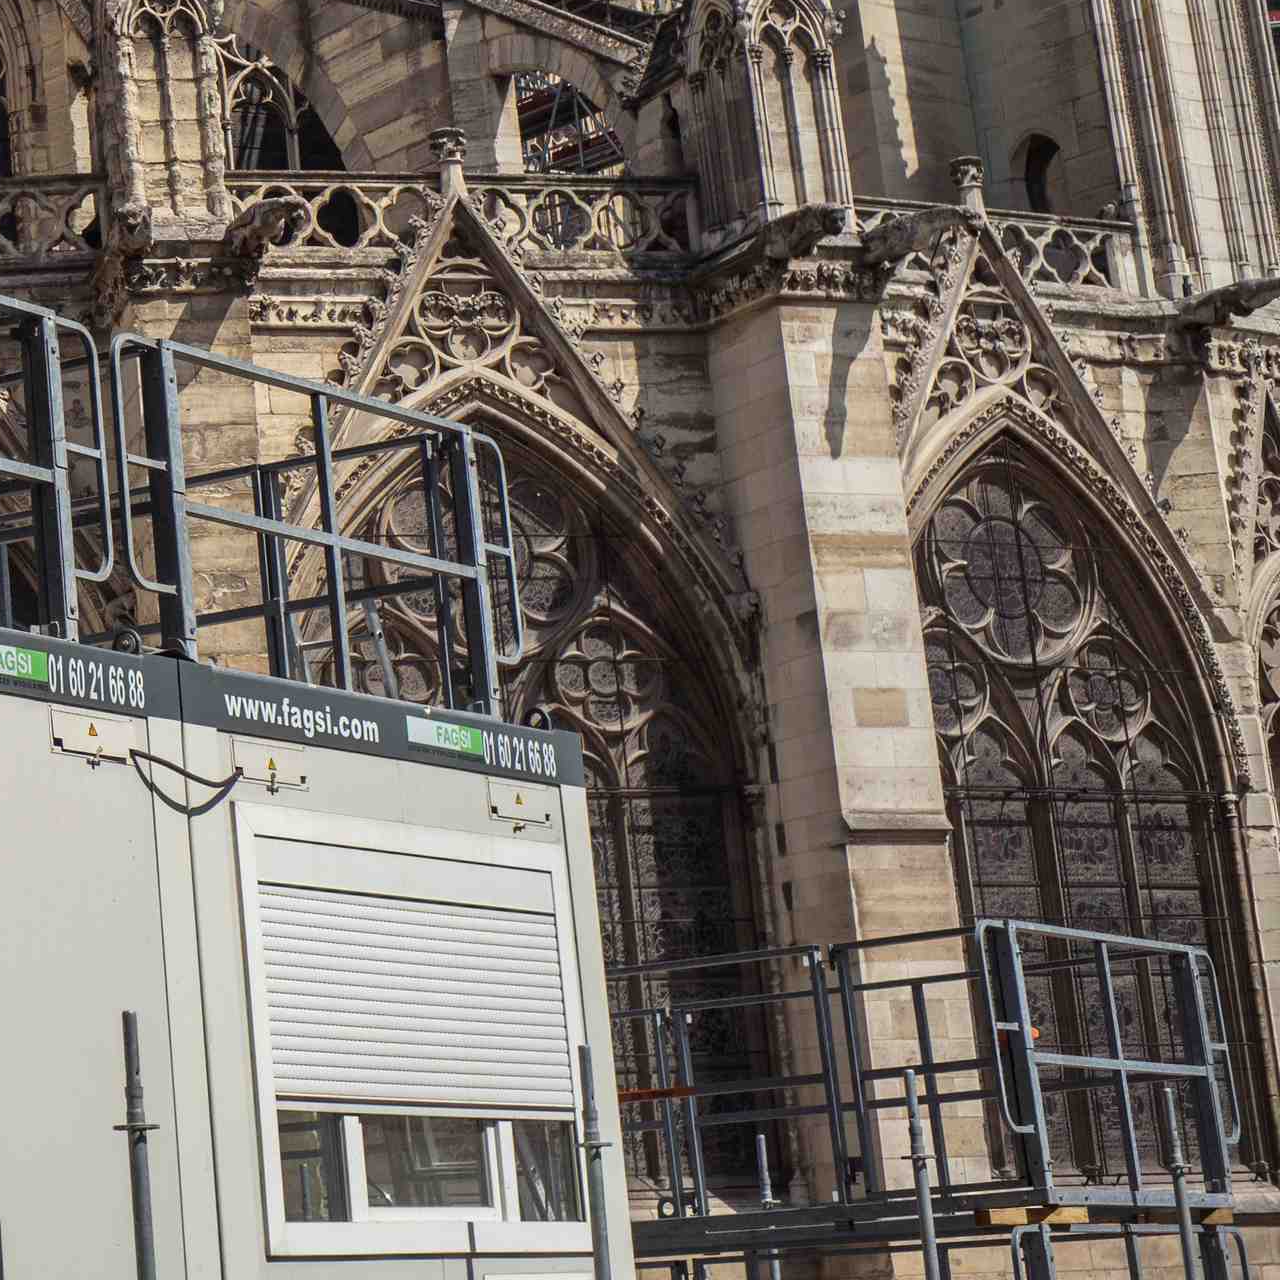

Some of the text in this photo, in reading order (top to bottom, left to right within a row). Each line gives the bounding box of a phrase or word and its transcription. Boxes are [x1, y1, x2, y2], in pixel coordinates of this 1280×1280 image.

[48, 653, 145, 709] 01 60 21 66 88
[224, 694, 380, 743] www.fagsi.com
[436, 726, 472, 749] FAGSI
[483, 730, 496, 766] 01
[498, 733, 512, 769] 60
[513, 736, 526, 771] 21
[528, 739, 542, 774] 66
[543, 742, 557, 778] 88
